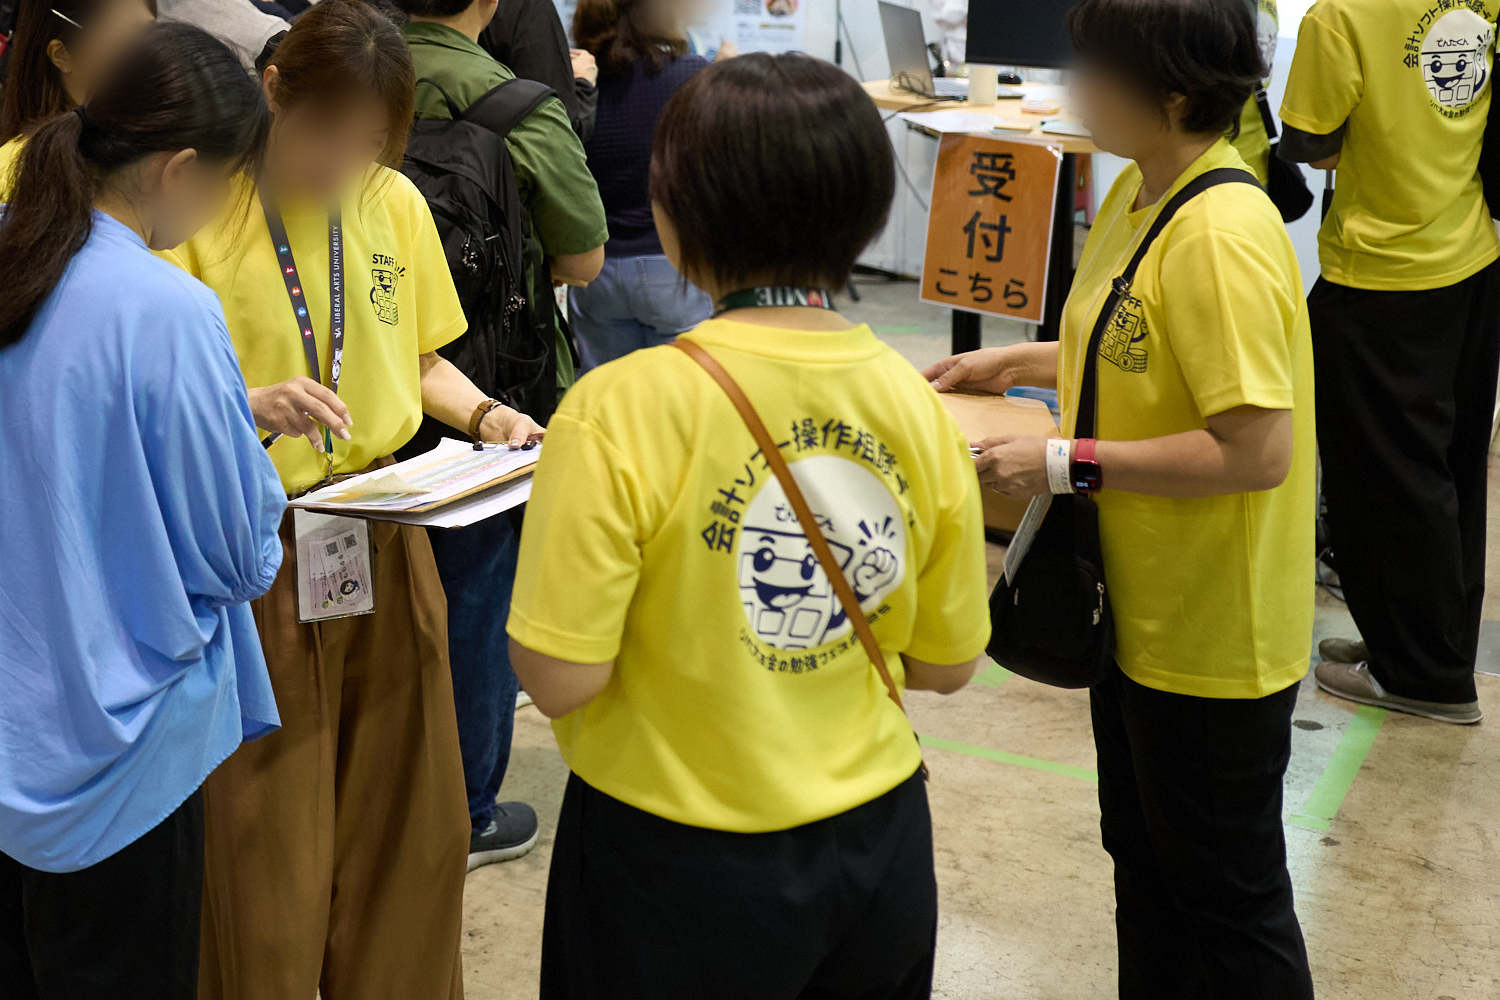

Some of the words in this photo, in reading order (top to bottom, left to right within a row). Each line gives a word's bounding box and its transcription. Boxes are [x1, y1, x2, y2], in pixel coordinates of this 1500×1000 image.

[1436, 38, 1470, 48] でんたくん
[962, 150, 1017, 264] 受付
[332, 224, 340, 271] UNIVERSITY
[372, 253, 395, 267] STAFF
[935, 267, 1029, 310] こちら
[333, 293, 341, 324] LIBERAL
